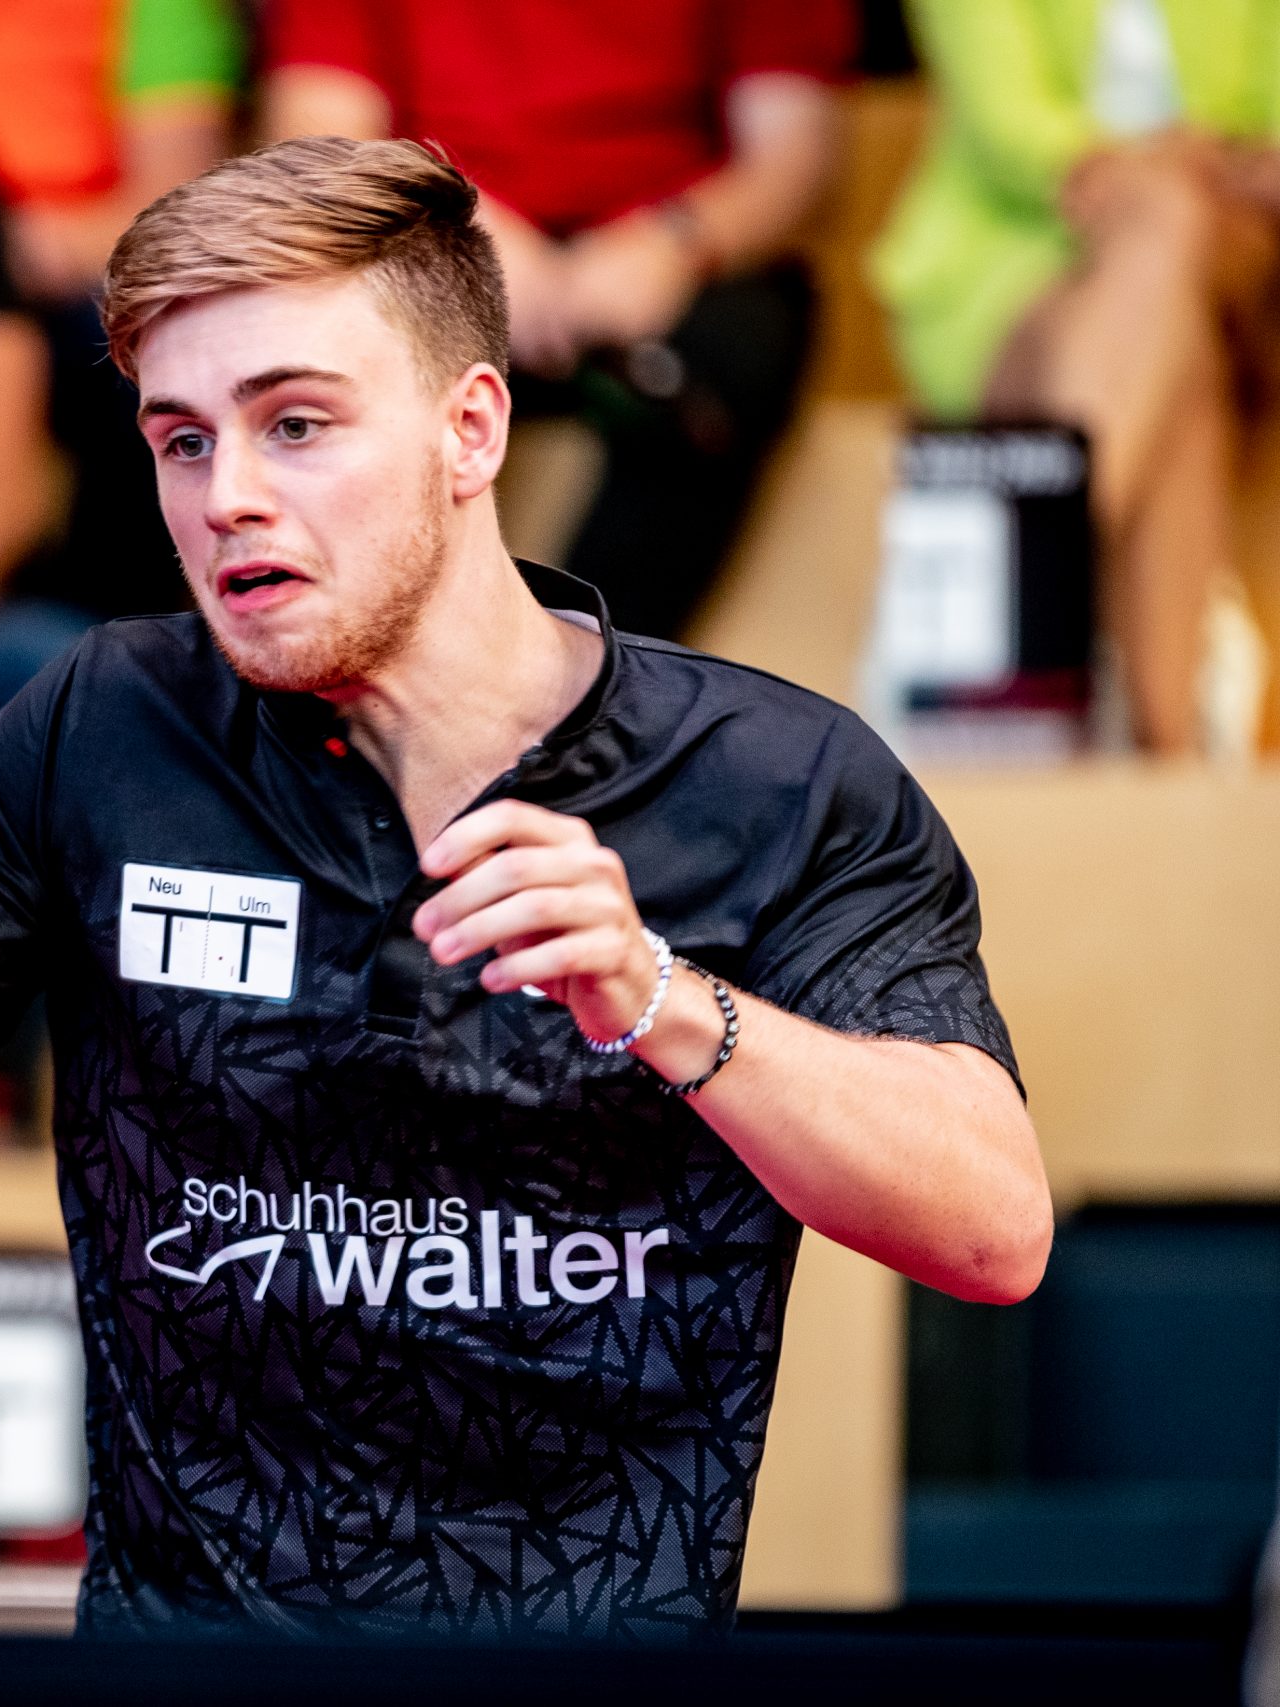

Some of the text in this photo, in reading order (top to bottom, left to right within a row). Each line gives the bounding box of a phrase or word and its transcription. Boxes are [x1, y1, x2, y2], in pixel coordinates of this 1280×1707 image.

[148, 876, 271, 914] Neu Ulm
[183, 1176, 469, 1235] schuhhaus
[307, 1210, 669, 1309] walter
